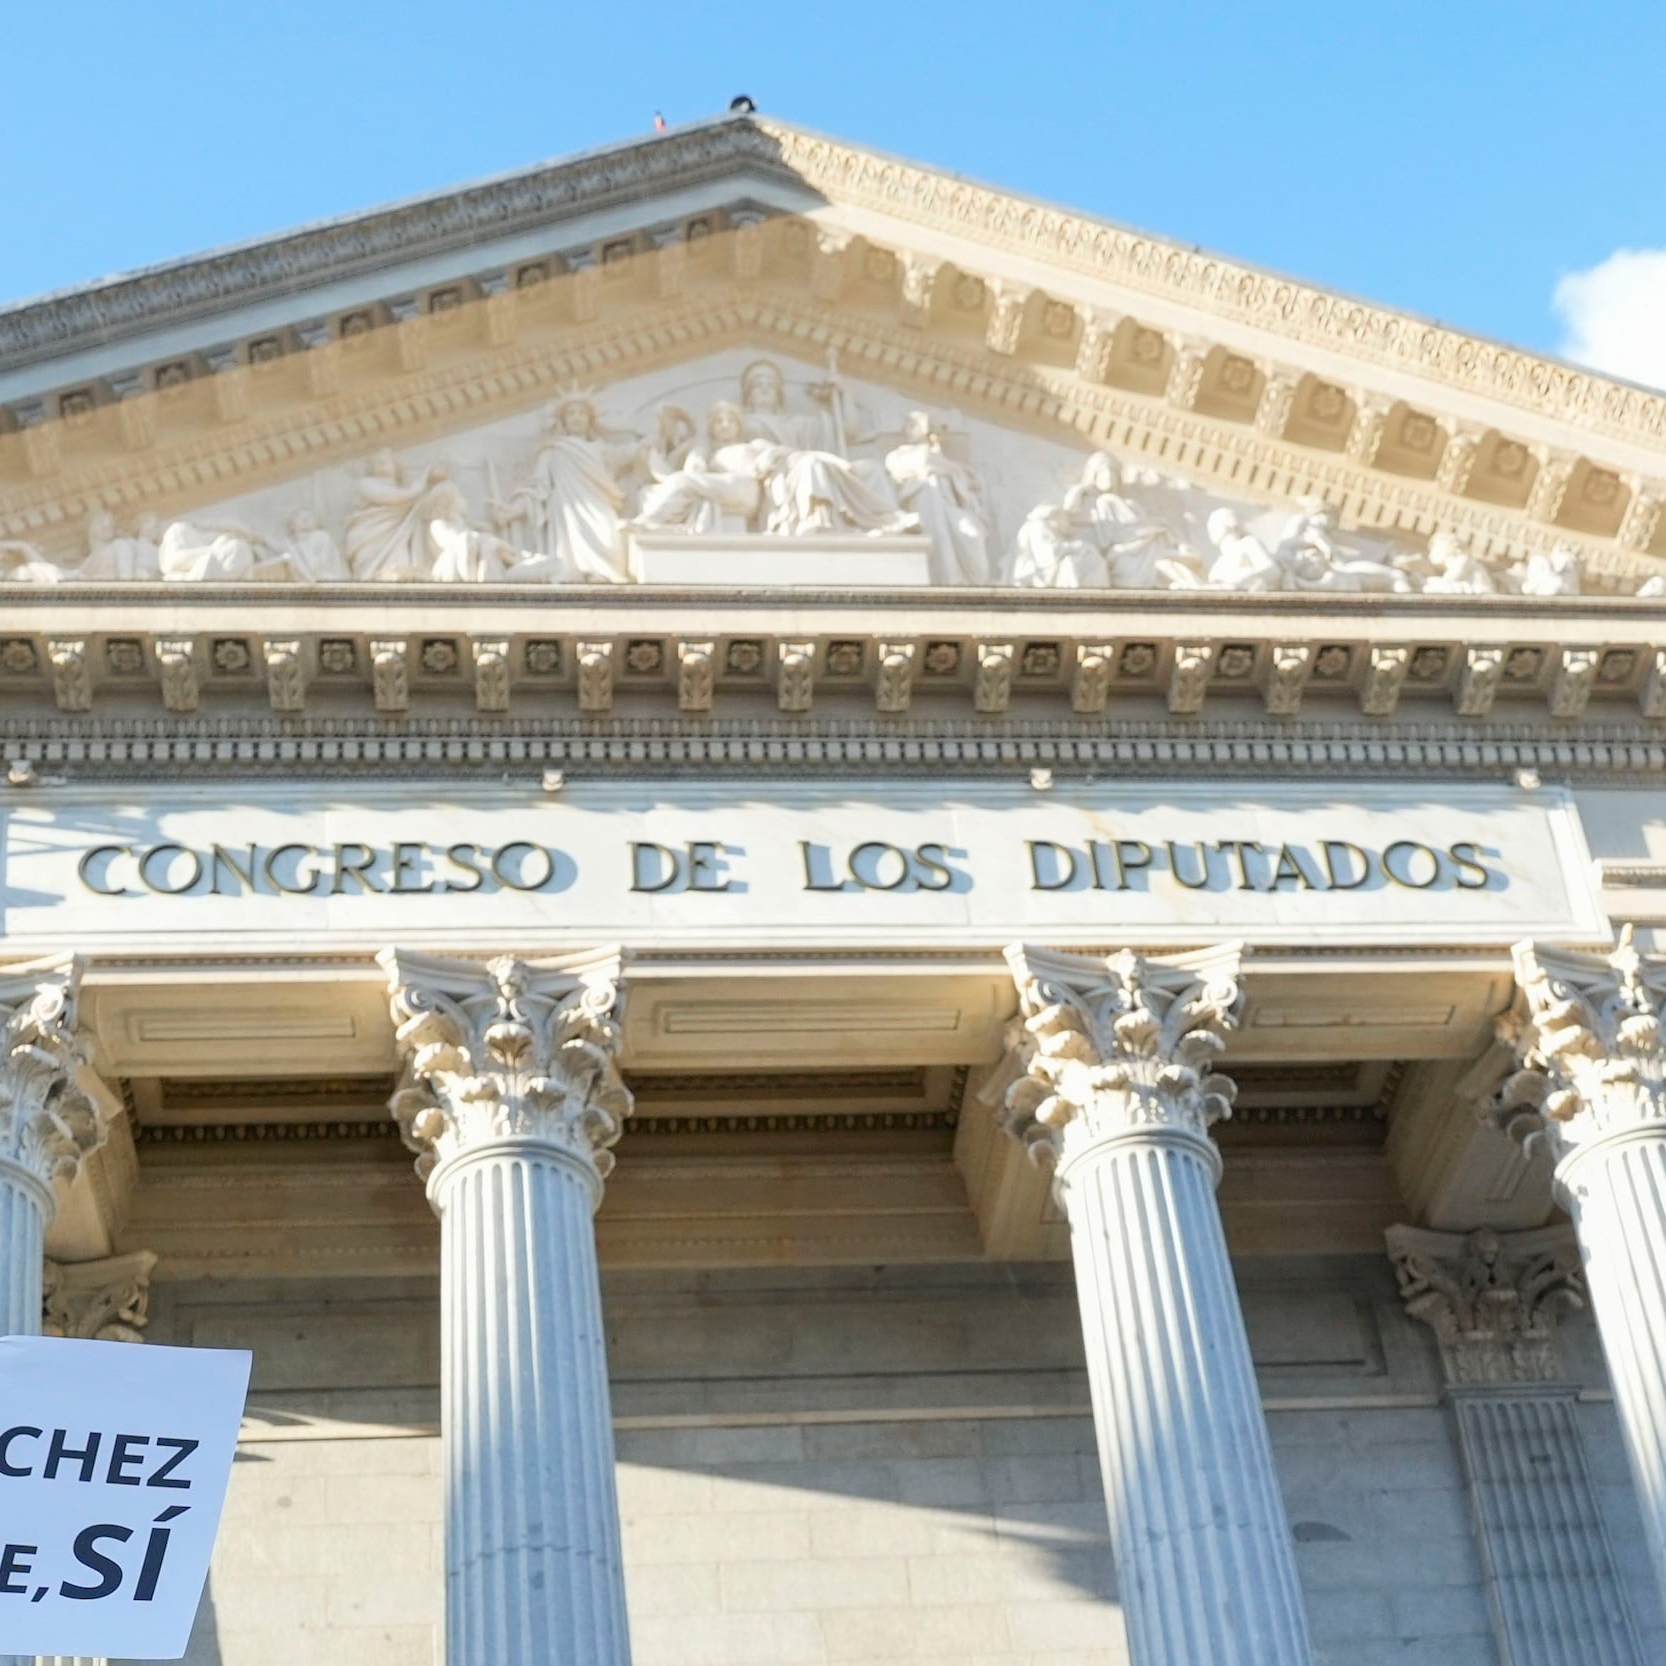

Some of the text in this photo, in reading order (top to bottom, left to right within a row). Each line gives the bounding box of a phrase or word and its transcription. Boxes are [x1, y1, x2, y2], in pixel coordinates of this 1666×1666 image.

[77, 839, 1491, 896] CONGRESO DE LOS DIPUTADOS
